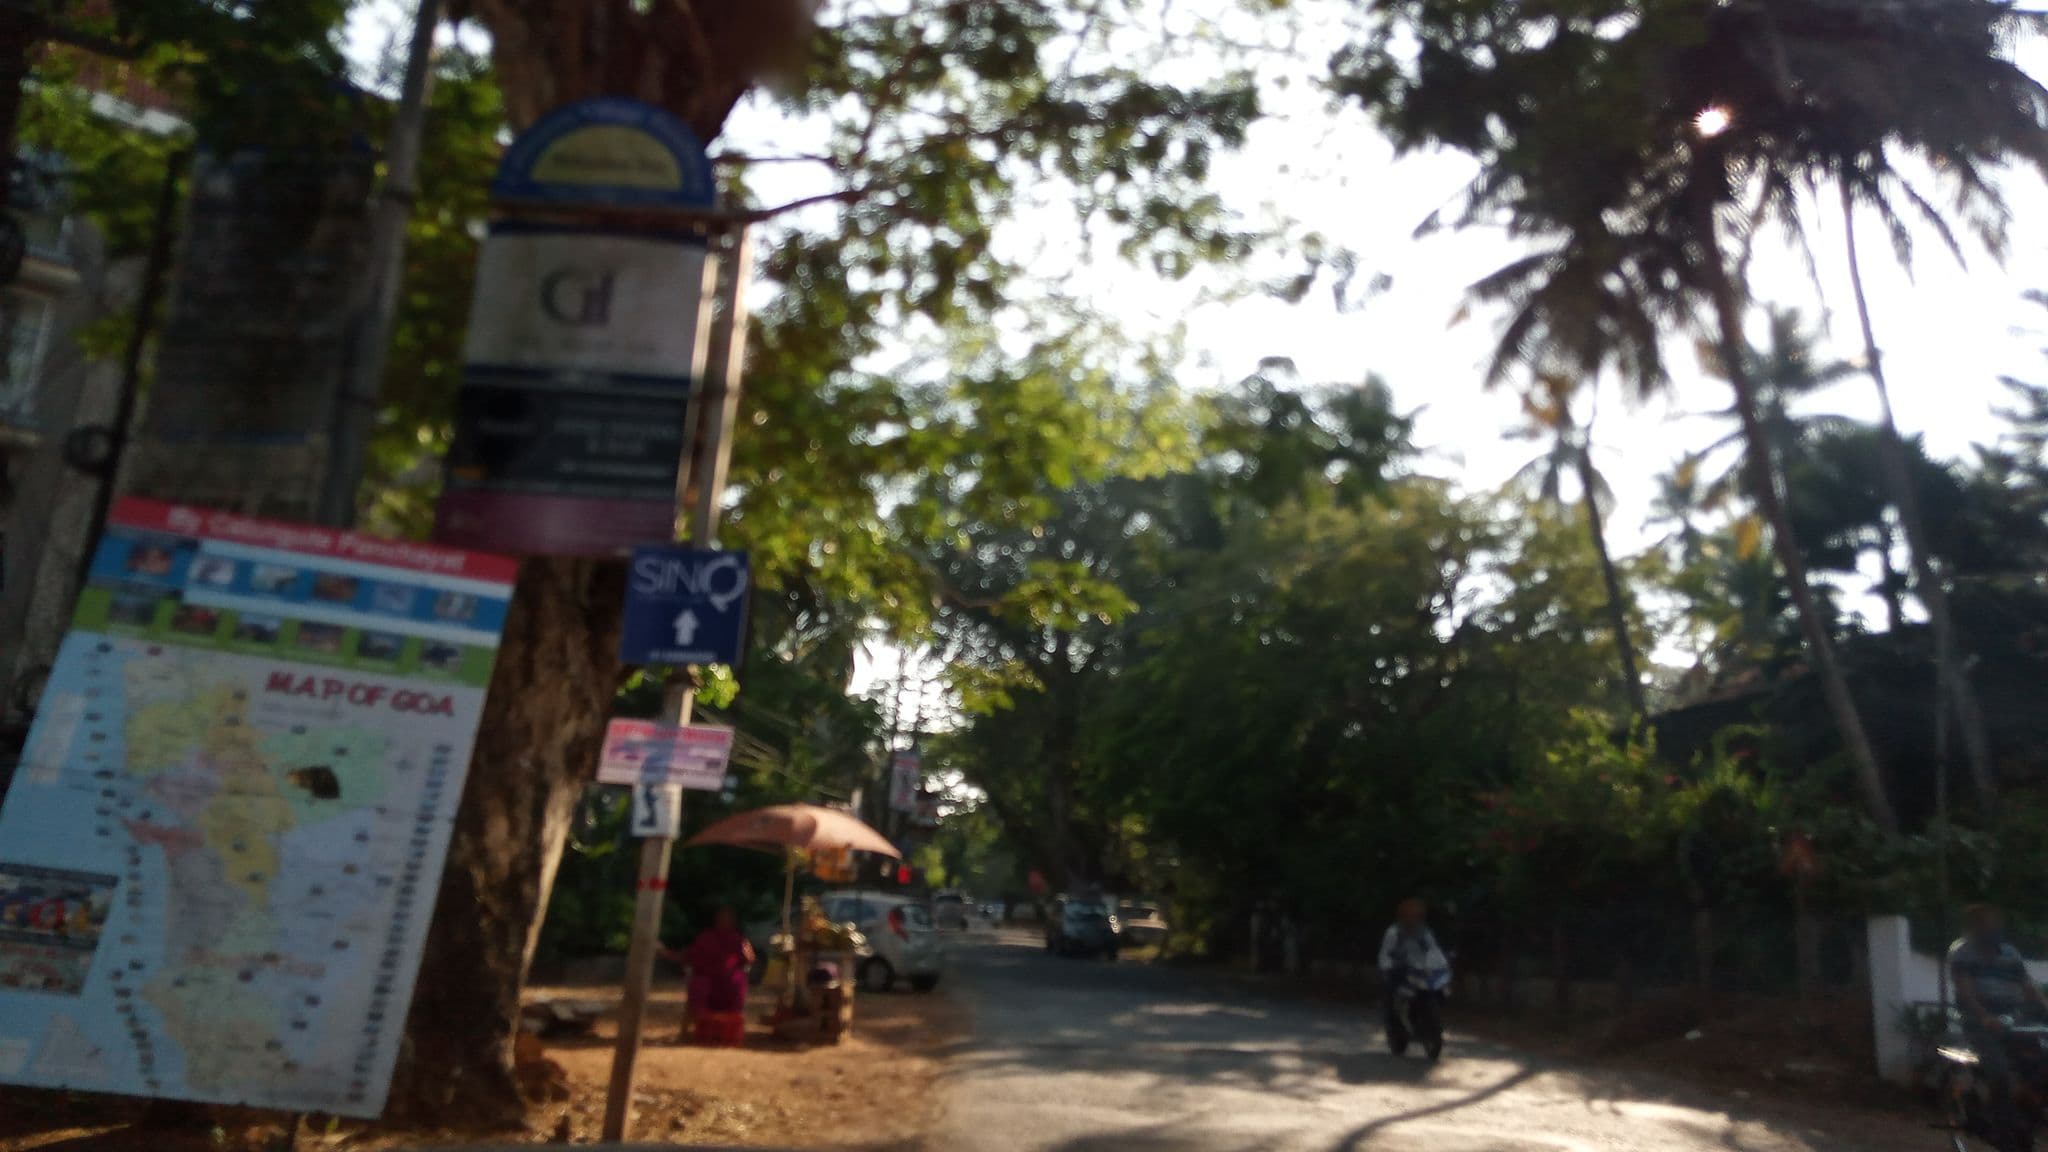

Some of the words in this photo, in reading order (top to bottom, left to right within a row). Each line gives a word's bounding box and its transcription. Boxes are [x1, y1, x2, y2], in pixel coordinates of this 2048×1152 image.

[633, 556, 748, 612] SINQ
[266, 671, 345, 699] MAP
[349, 682, 386, 707] OF
[391, 688, 455, 717] GOA
